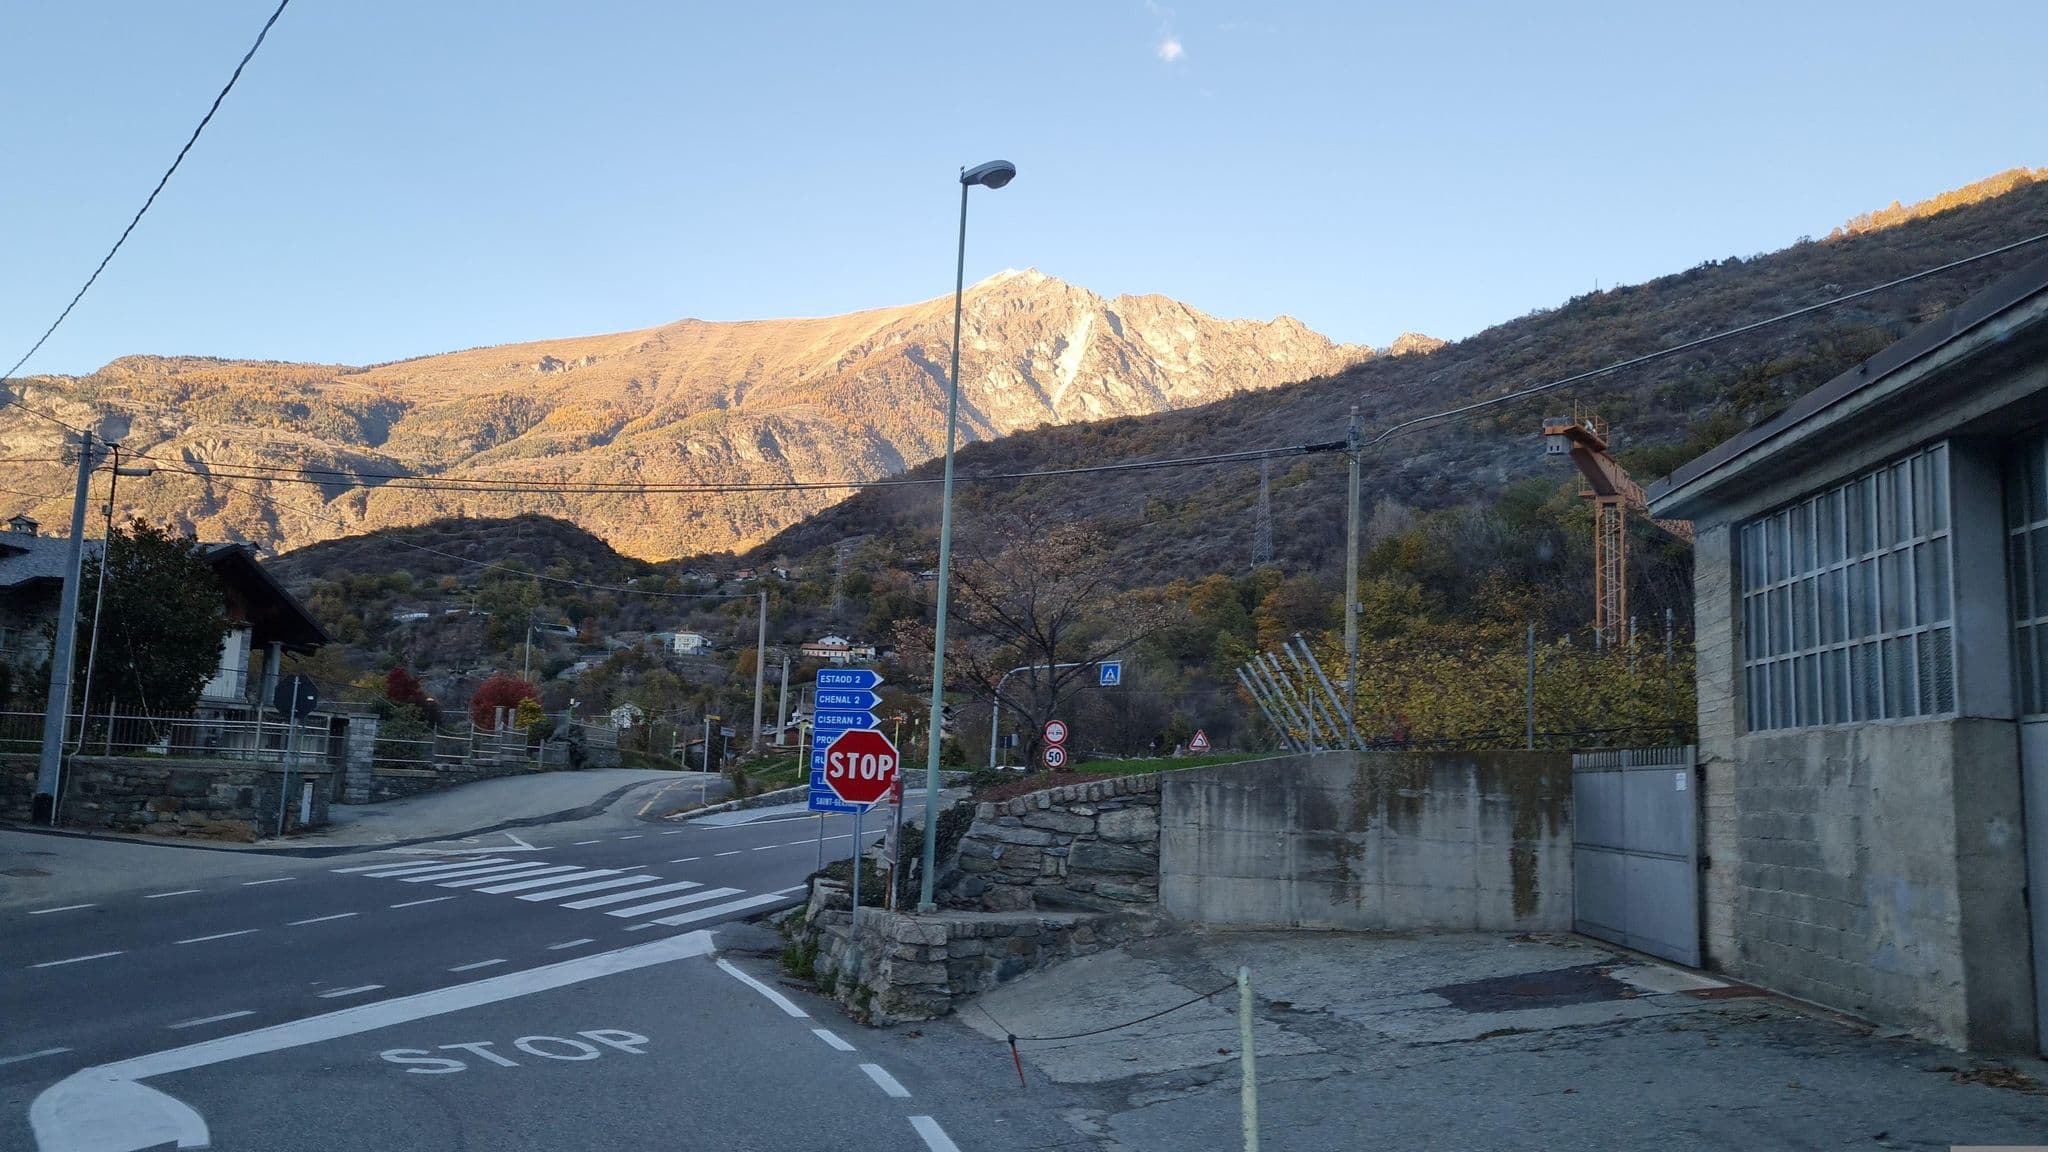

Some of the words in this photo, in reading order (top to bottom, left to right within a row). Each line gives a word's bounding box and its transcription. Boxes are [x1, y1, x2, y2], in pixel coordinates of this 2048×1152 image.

[820, 675, 852, 684] ESTAOD
[855, 675, 861, 684] 2
[819, 695, 851, 704] CHENAL
[854, 696, 860, 704] 2
[817, 716, 853, 725] CISERAN
[856, 717, 862, 725] 2
[1048, 751, 1062, 763] 50
[830, 751, 894, 781] STOP
[379, 1029, 650, 1074] STOP
